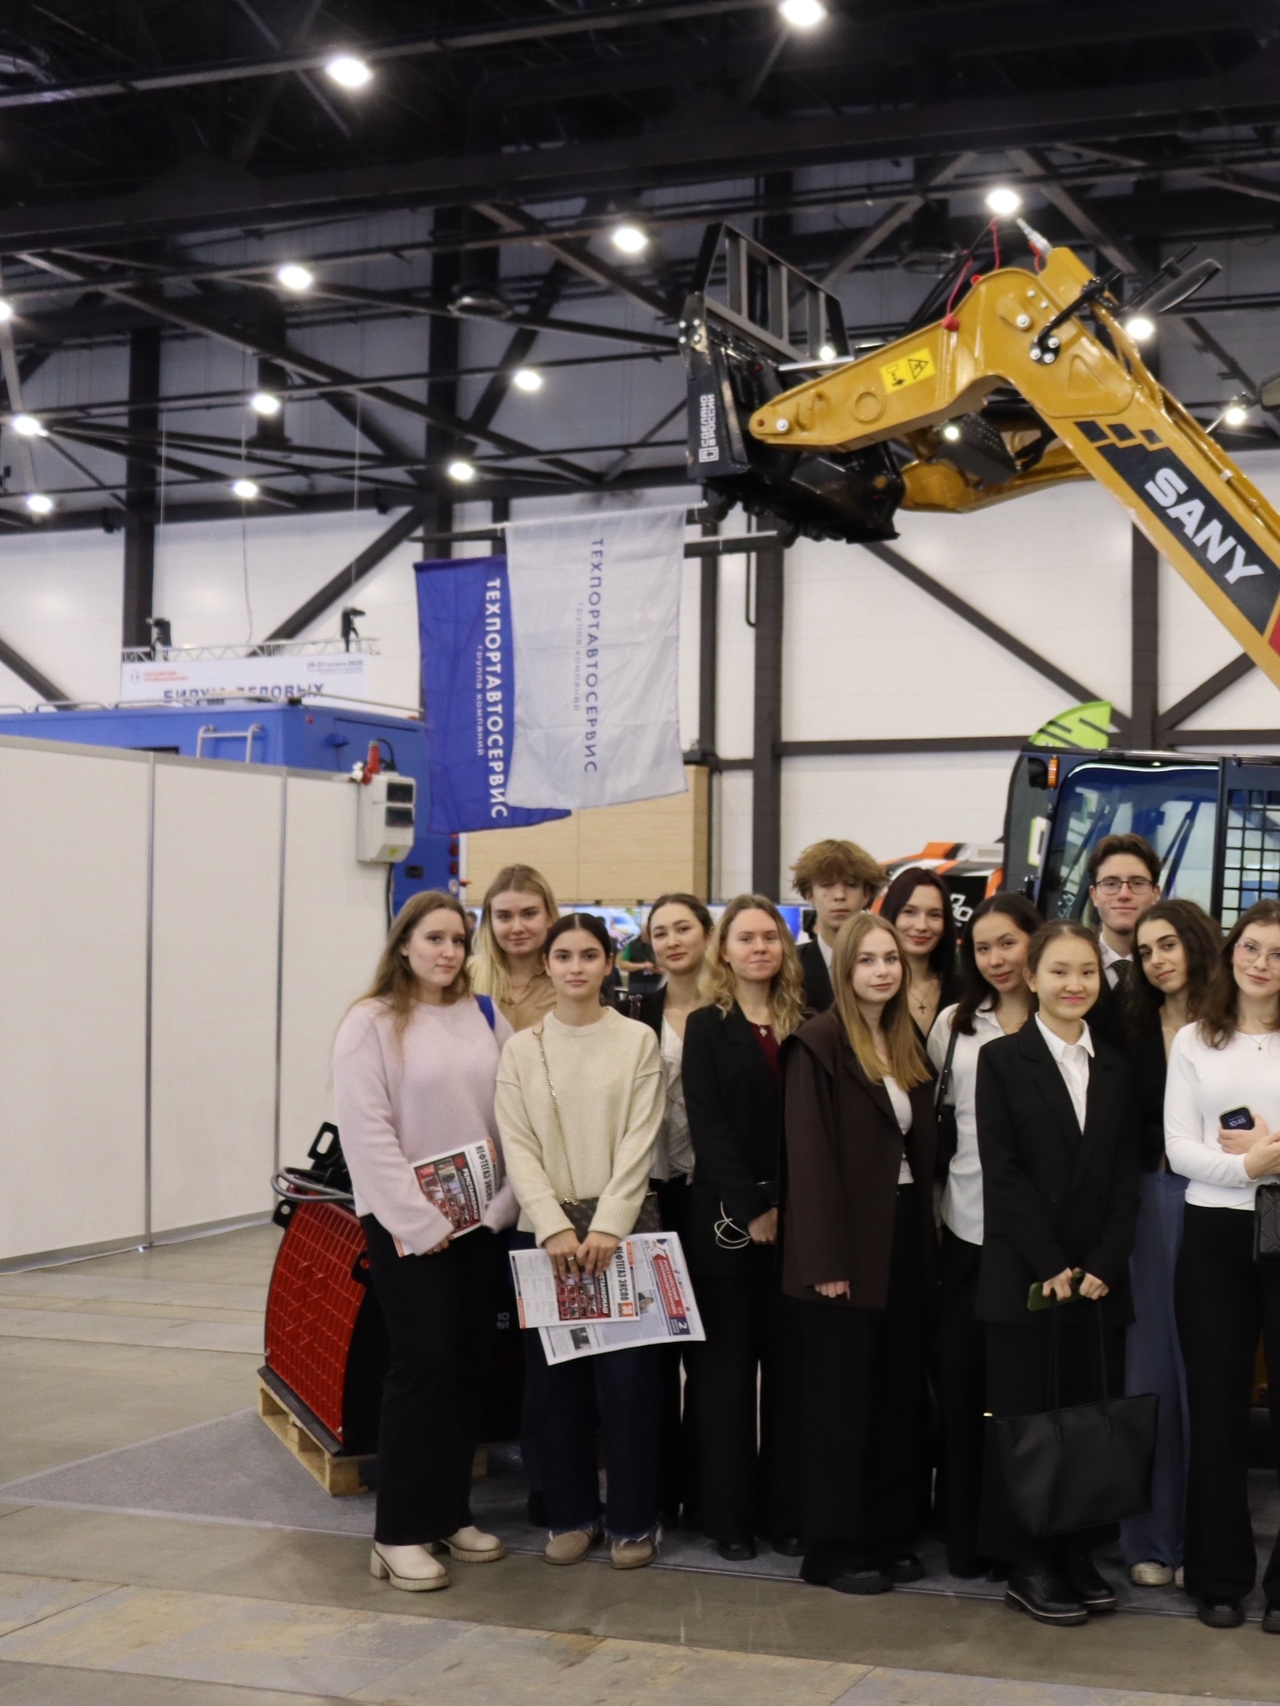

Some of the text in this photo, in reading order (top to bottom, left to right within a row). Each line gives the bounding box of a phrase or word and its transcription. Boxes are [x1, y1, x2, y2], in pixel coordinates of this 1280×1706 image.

[700, 395, 708, 447] СДЕЛАНО
[1144, 466, 1264, 584] SANY
[476, 645, 484, 756] группа компаний
[486, 577, 508, 818] ТЕХПОРТАВТОСЕРВИС
[584, 538, 604, 773] ТЕХПОРТАВТОСЕРВИС
[618, 1279, 630, 1301] ЭКСПО
